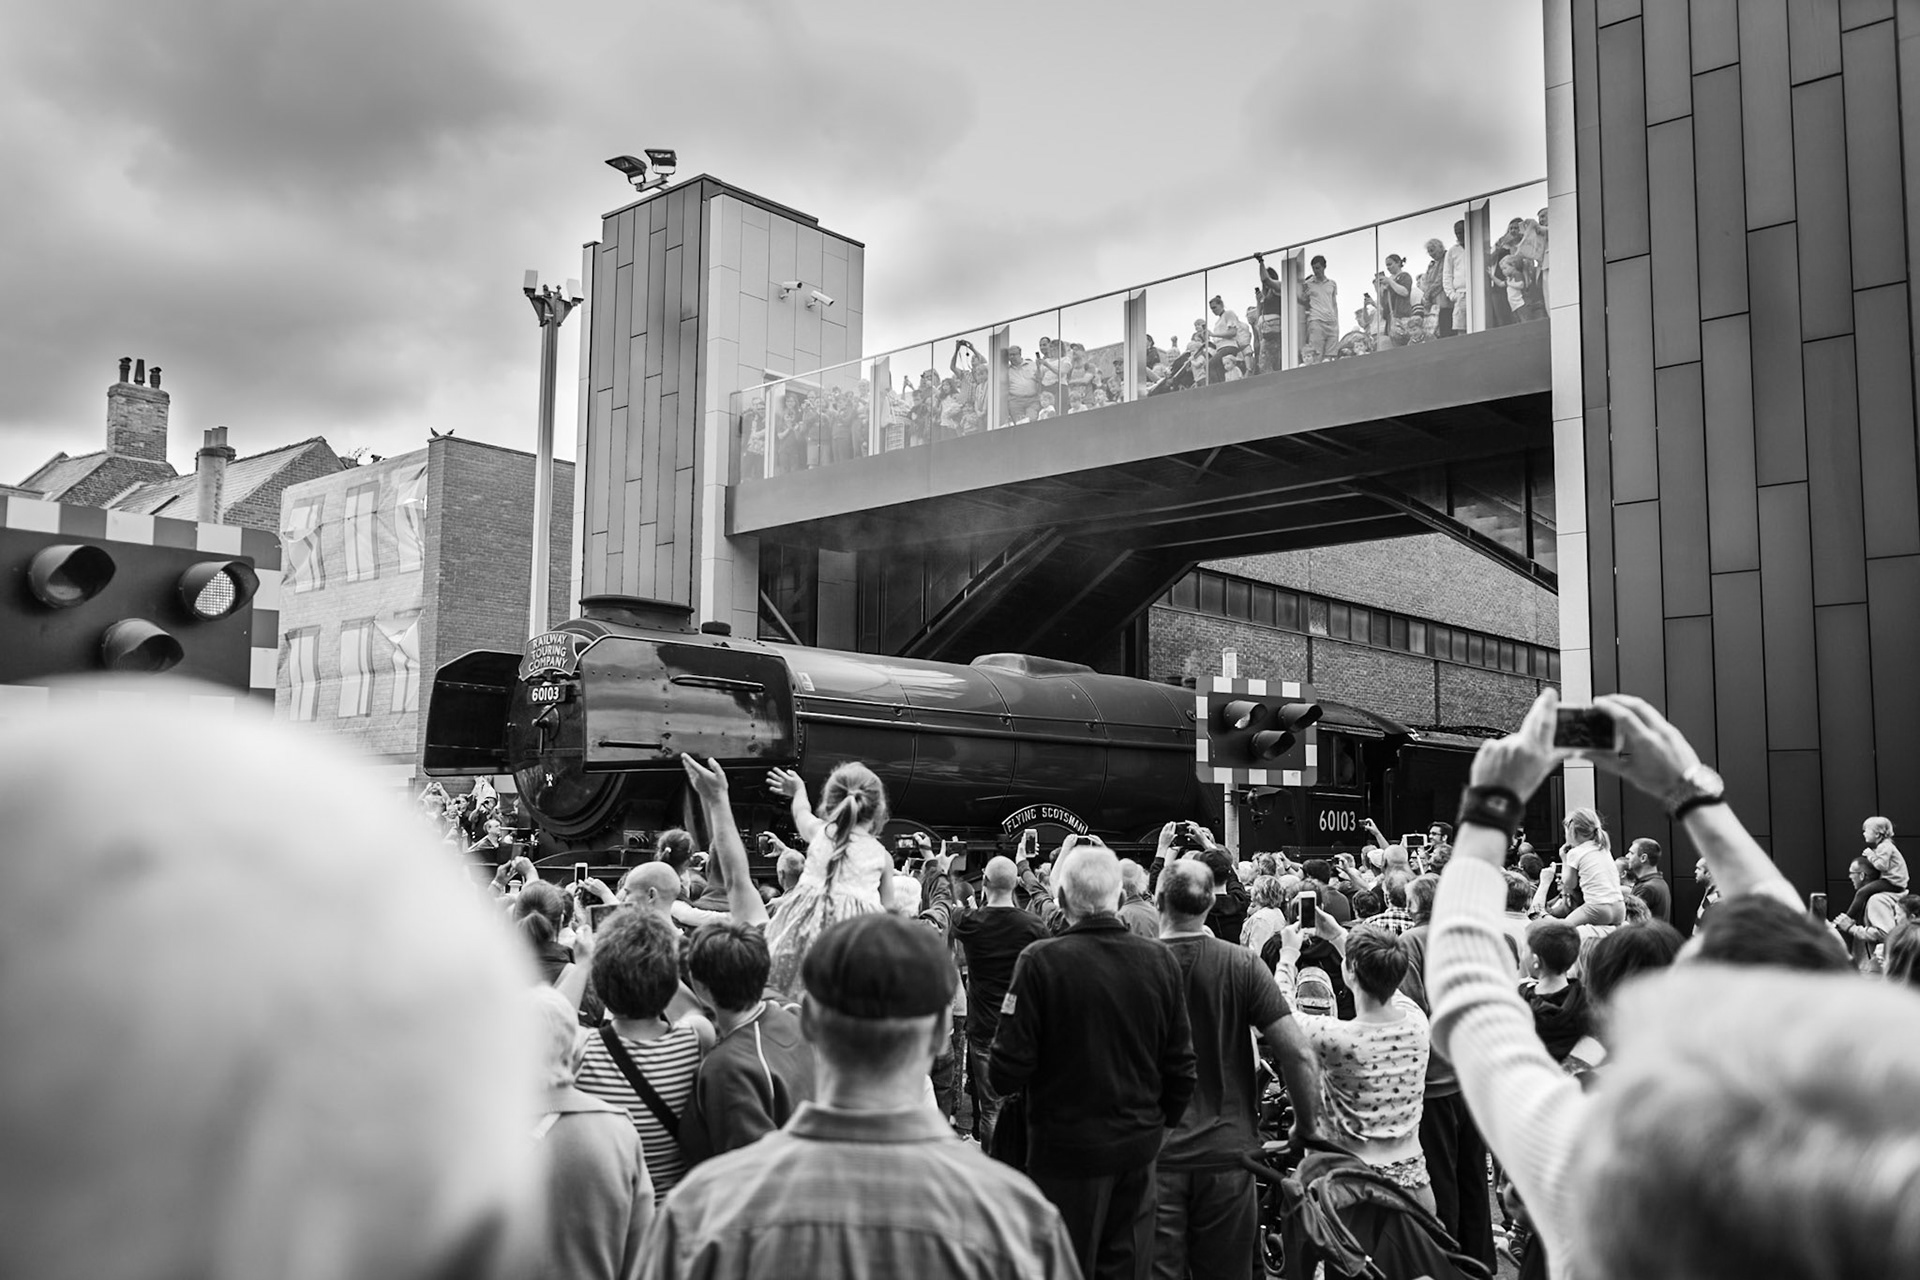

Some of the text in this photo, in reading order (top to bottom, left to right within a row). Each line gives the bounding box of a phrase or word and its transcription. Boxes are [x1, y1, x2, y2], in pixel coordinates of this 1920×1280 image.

[532, 633, 568, 649] RAILWAY
[531, 645, 567, 660] TOURING
[528, 656, 568, 672] COMPANY
[531, 686, 560, 702] 60103
[1006, 807, 1085, 834] FLYING SCOTSMAN
[1319, 809, 1356, 832] 60103
